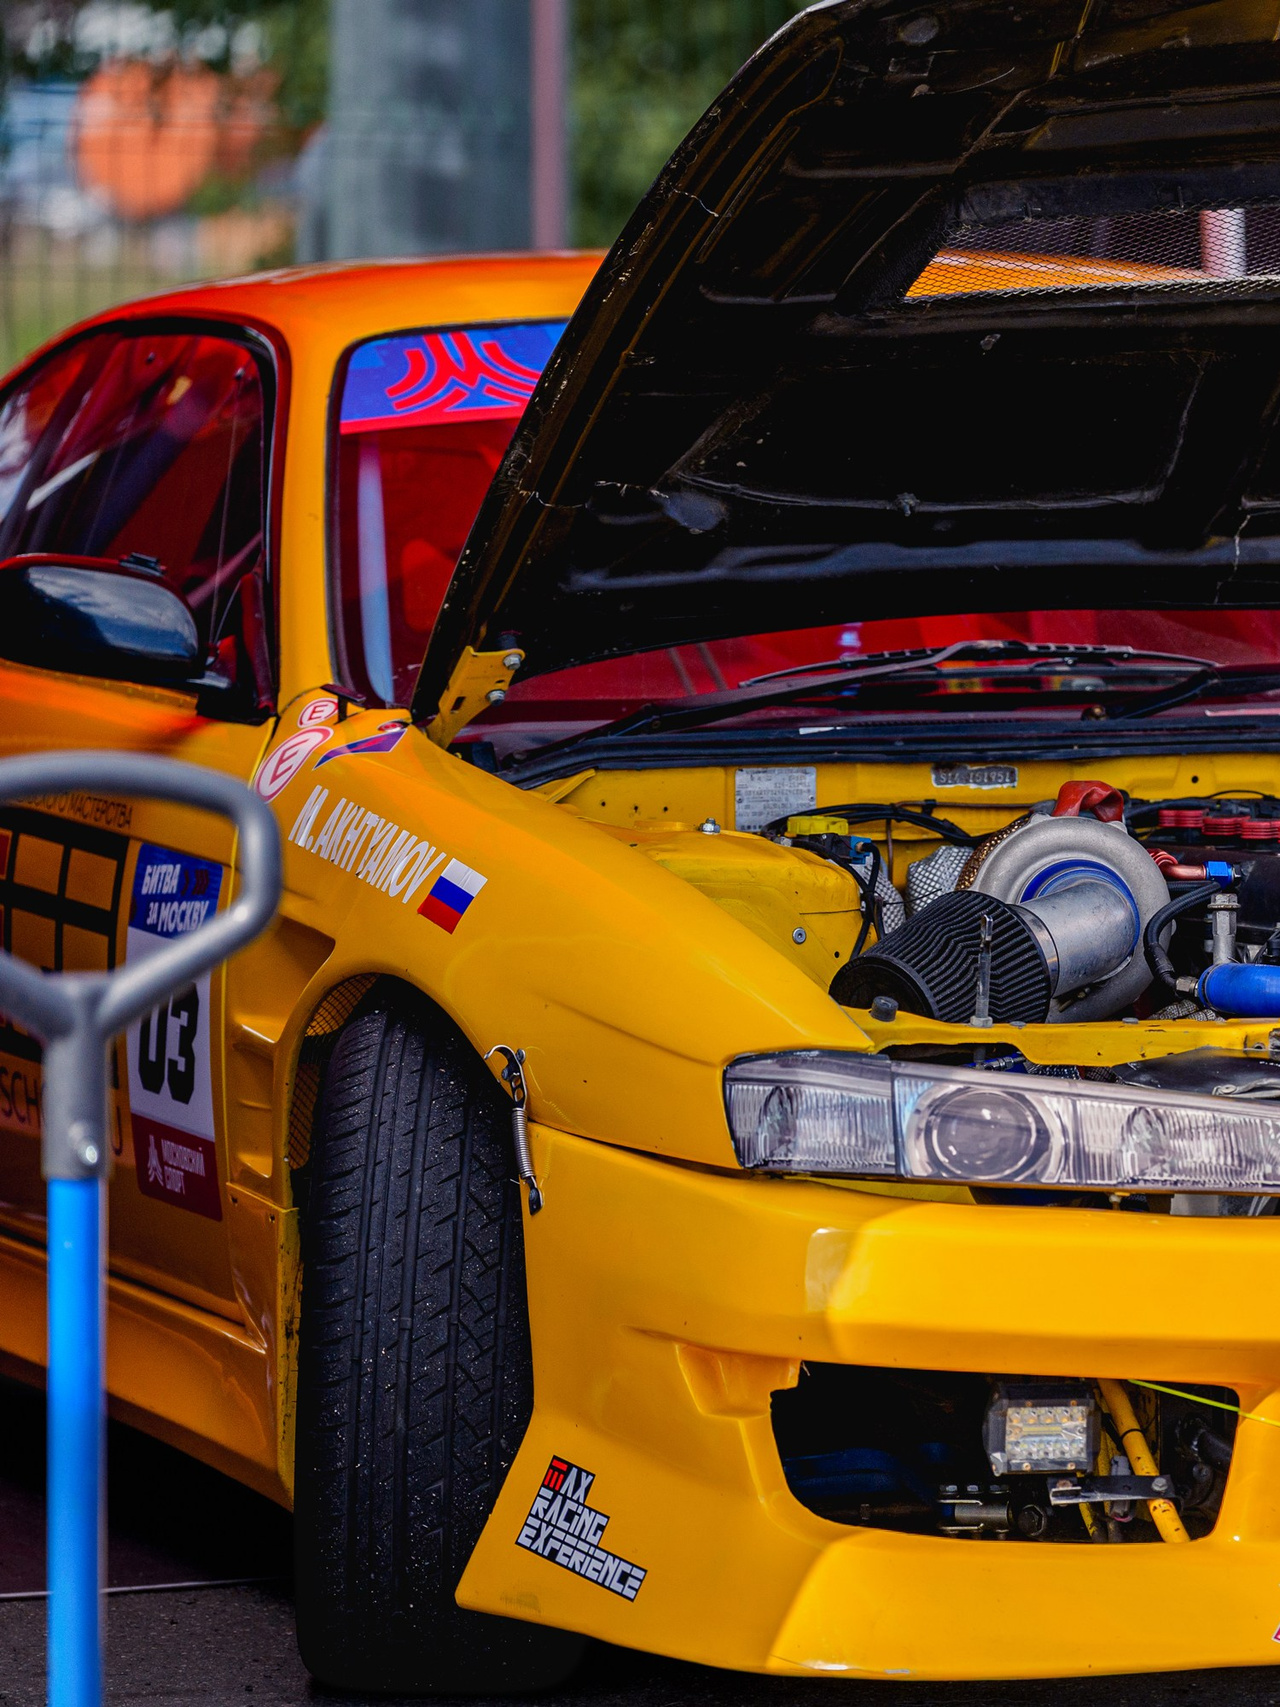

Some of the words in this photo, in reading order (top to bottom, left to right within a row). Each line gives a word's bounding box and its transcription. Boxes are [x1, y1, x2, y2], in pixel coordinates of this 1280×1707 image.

[269, 738, 309, 787] E
[141, 863, 181, 895] БИТВА
[146, 901, 159, 926] ЗА
[157, 900, 209, 933] МОСКВУ
[138, 982, 199, 1105] 03
[530, 1486, 609, 1546] RACING
[517, 1516, 646, 1600] EXPERIENCE
